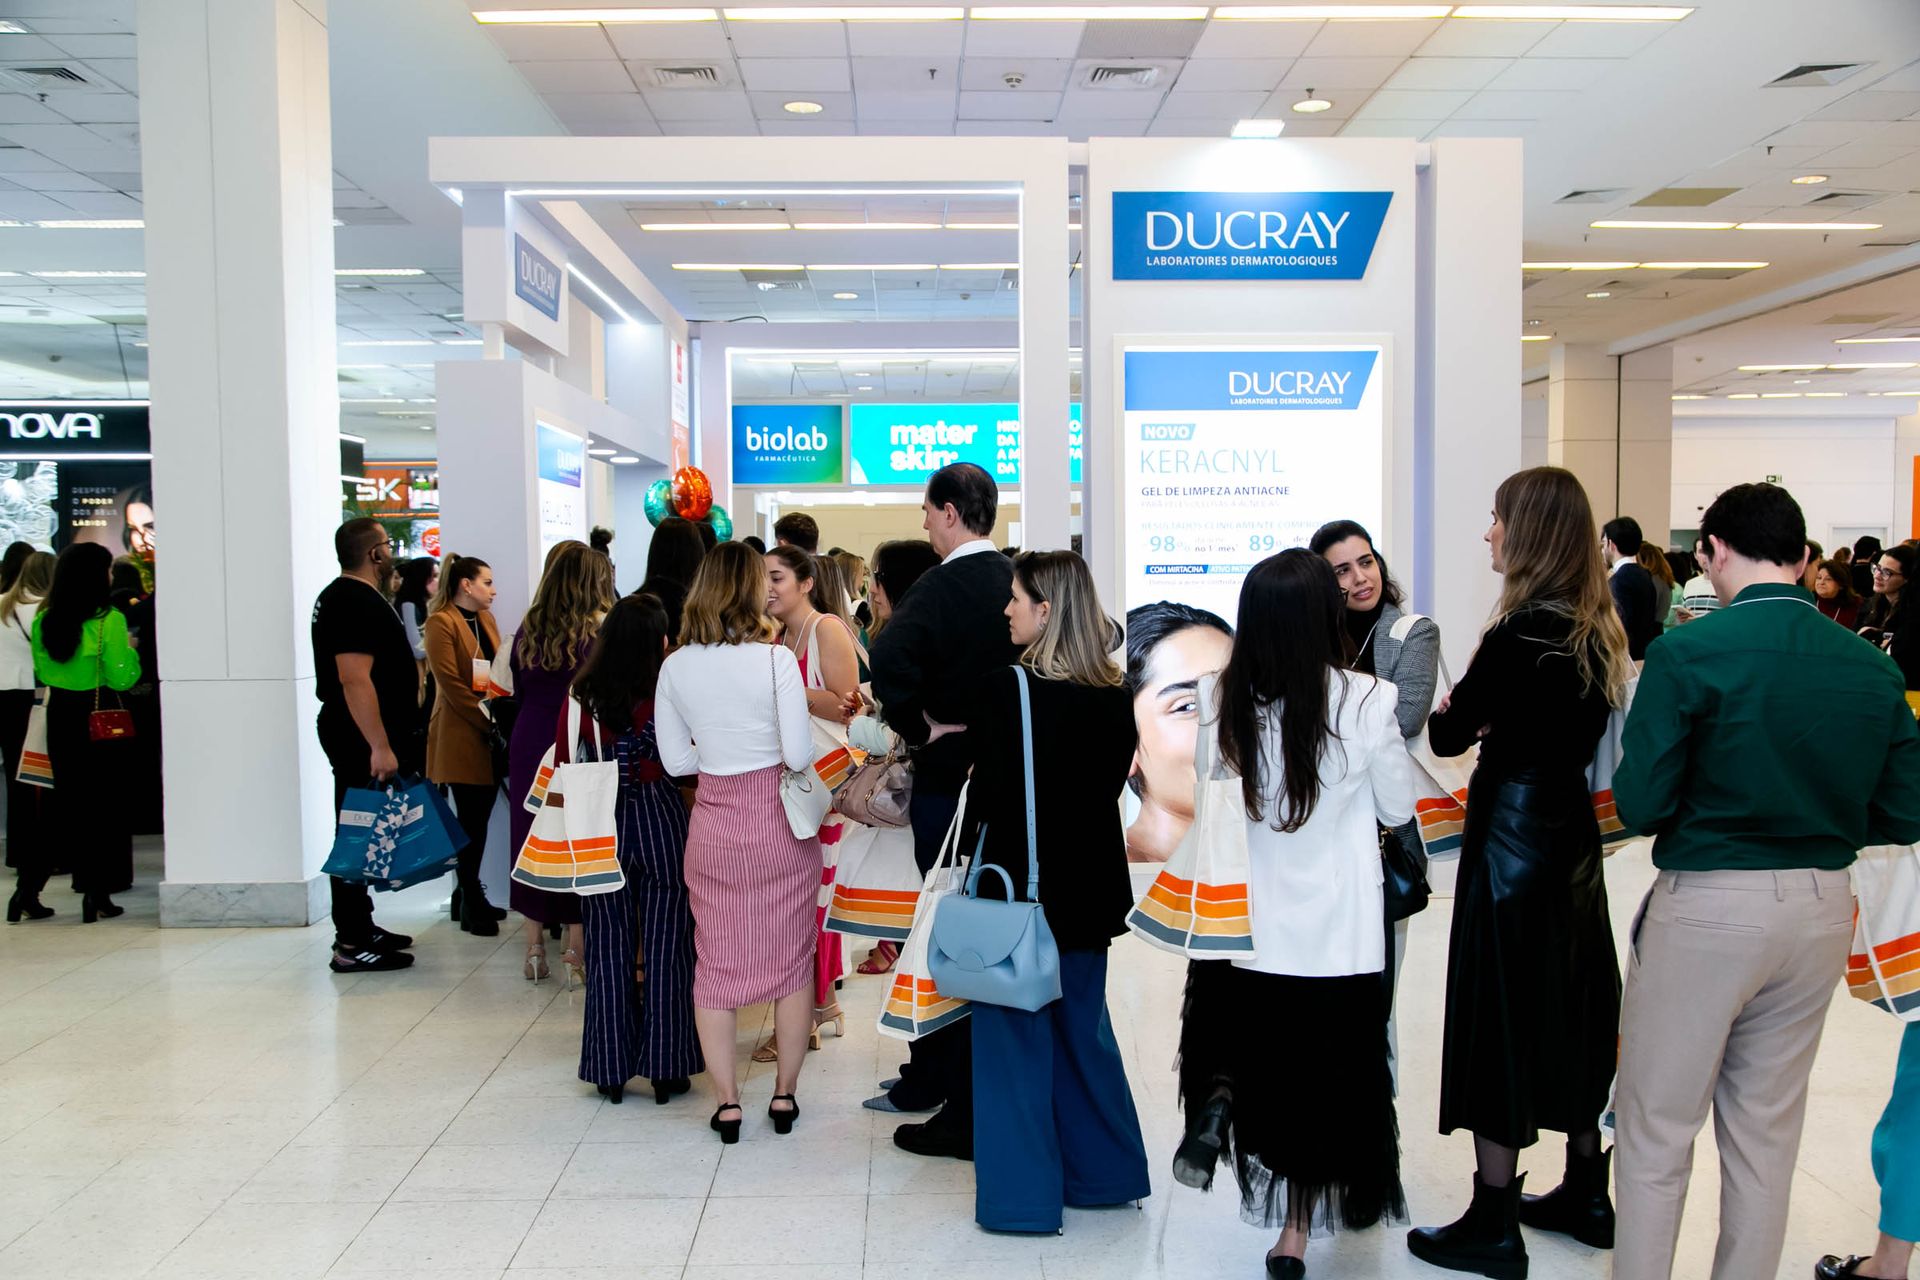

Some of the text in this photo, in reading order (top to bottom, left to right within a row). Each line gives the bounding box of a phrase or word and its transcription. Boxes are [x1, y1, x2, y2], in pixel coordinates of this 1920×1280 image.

[1146, 210, 1351, 251] DUCRAY
[1146, 255, 1338, 267] LABORATOIRES DERMATOLOGIQUES
[1228, 370, 1352, 396] DUCRAY
[1230, 397, 1343, 406] LABORATOIRES DERMATOLOGIQUES
[745, 424, 828, 452] biolab
[889, 420, 979, 445] mater
[1144, 425, 1190, 440] NOVO
[754, 454, 817, 463] FARMACÊUTICA
[1140, 449, 1286, 474] KERACNYL
[1141, 486, 1291, 497] GEL DE LIMPEZA ANTIACNE
[72, 508, 91, 516] DOS
